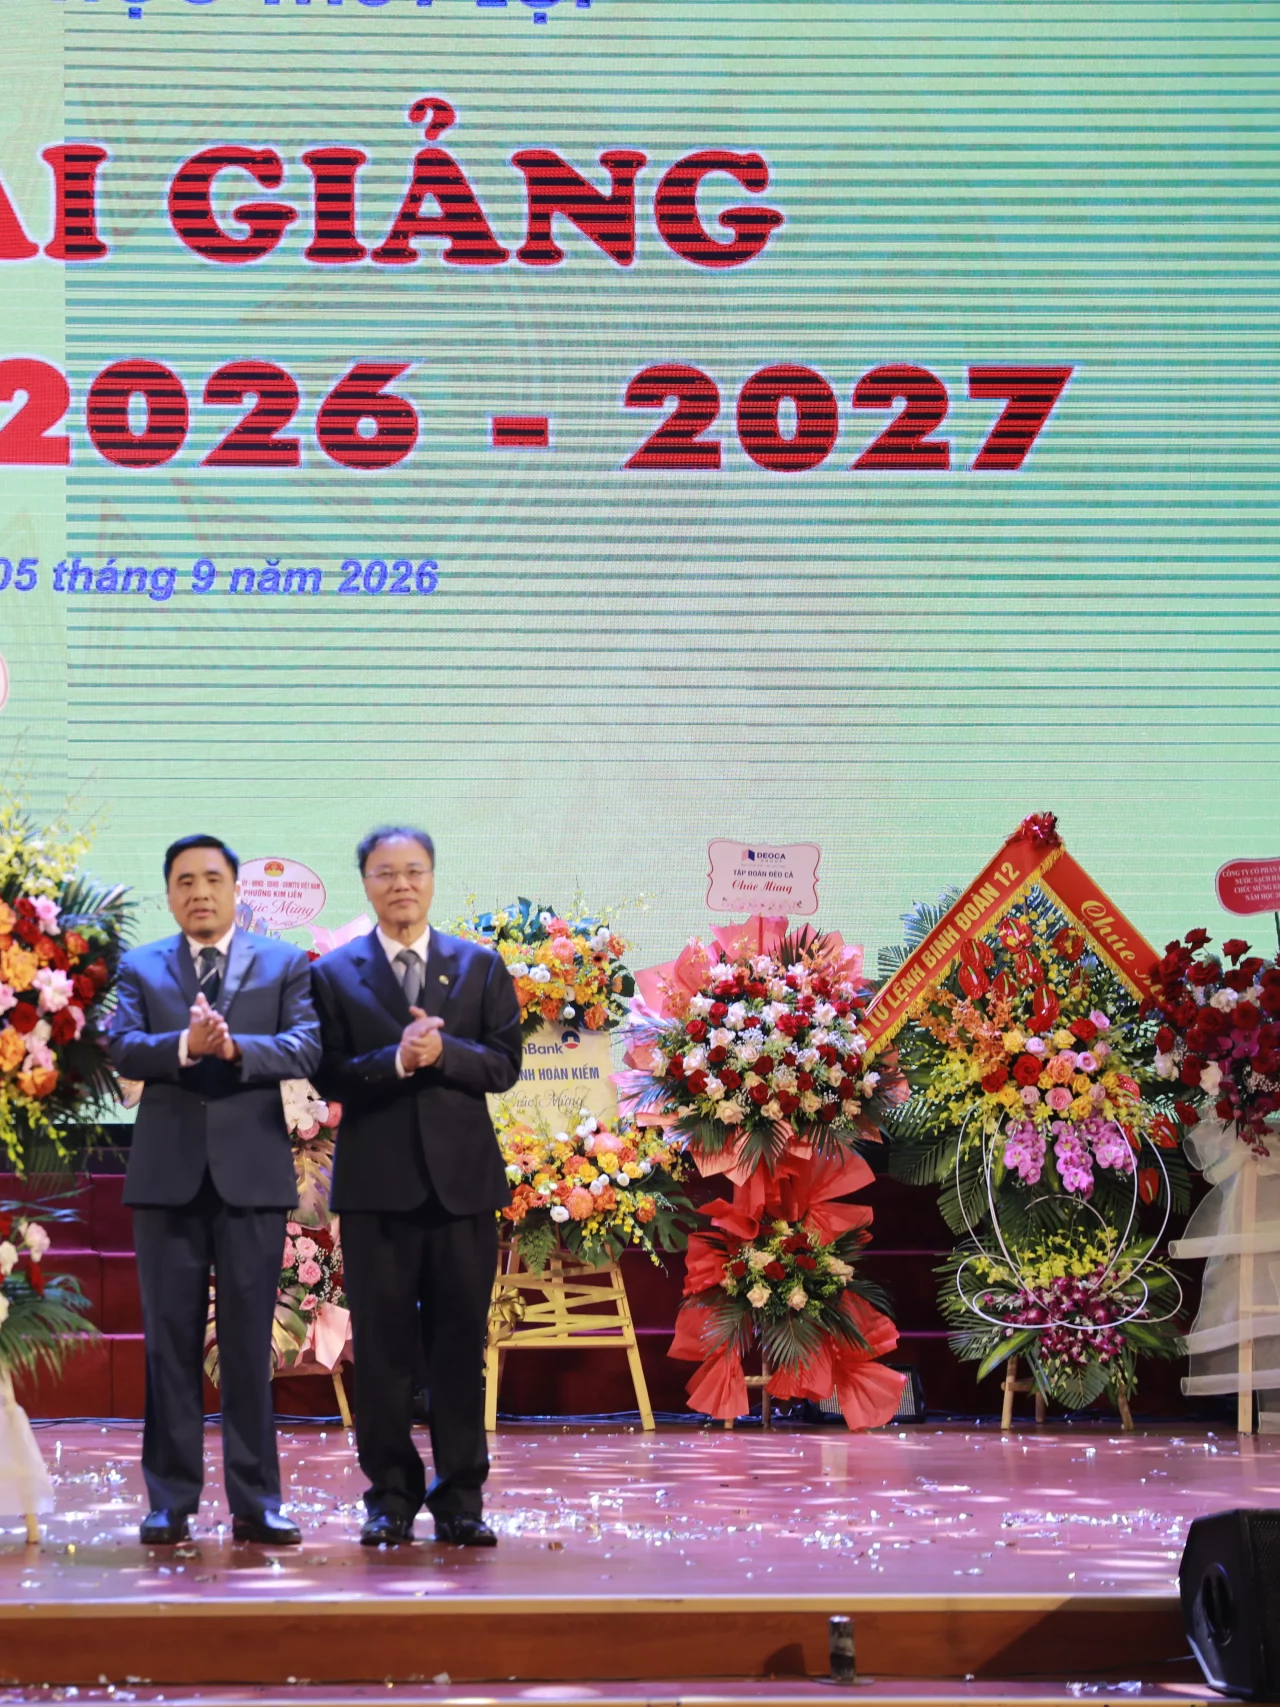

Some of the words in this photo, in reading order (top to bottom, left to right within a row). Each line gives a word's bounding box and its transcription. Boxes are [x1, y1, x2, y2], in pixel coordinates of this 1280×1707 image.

[168, 97, 784, 269] GIẢNG
[492, 415, 550, 448] -
[621, 363, 1076, 472] 2027
[52, 556, 178, 601] tháng
[191, 558, 218, 594] 9
[229, 556, 322, 594] năm
[337, 559, 440, 595] 2026
[756, 852, 786, 860] DEOCA
[1241, 868, 1249, 876] TY
[271, 899, 315, 920] Mừng
[273, 890, 287, 898] KIM
[287, 890, 303, 899] LIÊN
[885, 963, 927, 1009] LỆNH
[921, 924, 961, 969] BINH
[954, 881, 1001, 932] ĐOÀN
[993, 861, 1021, 888] 12
[1081, 900, 1136, 965] Chúc
[538, 1065, 569, 1081] HOÀN
[571, 1062, 600, 1081] KIẾM
